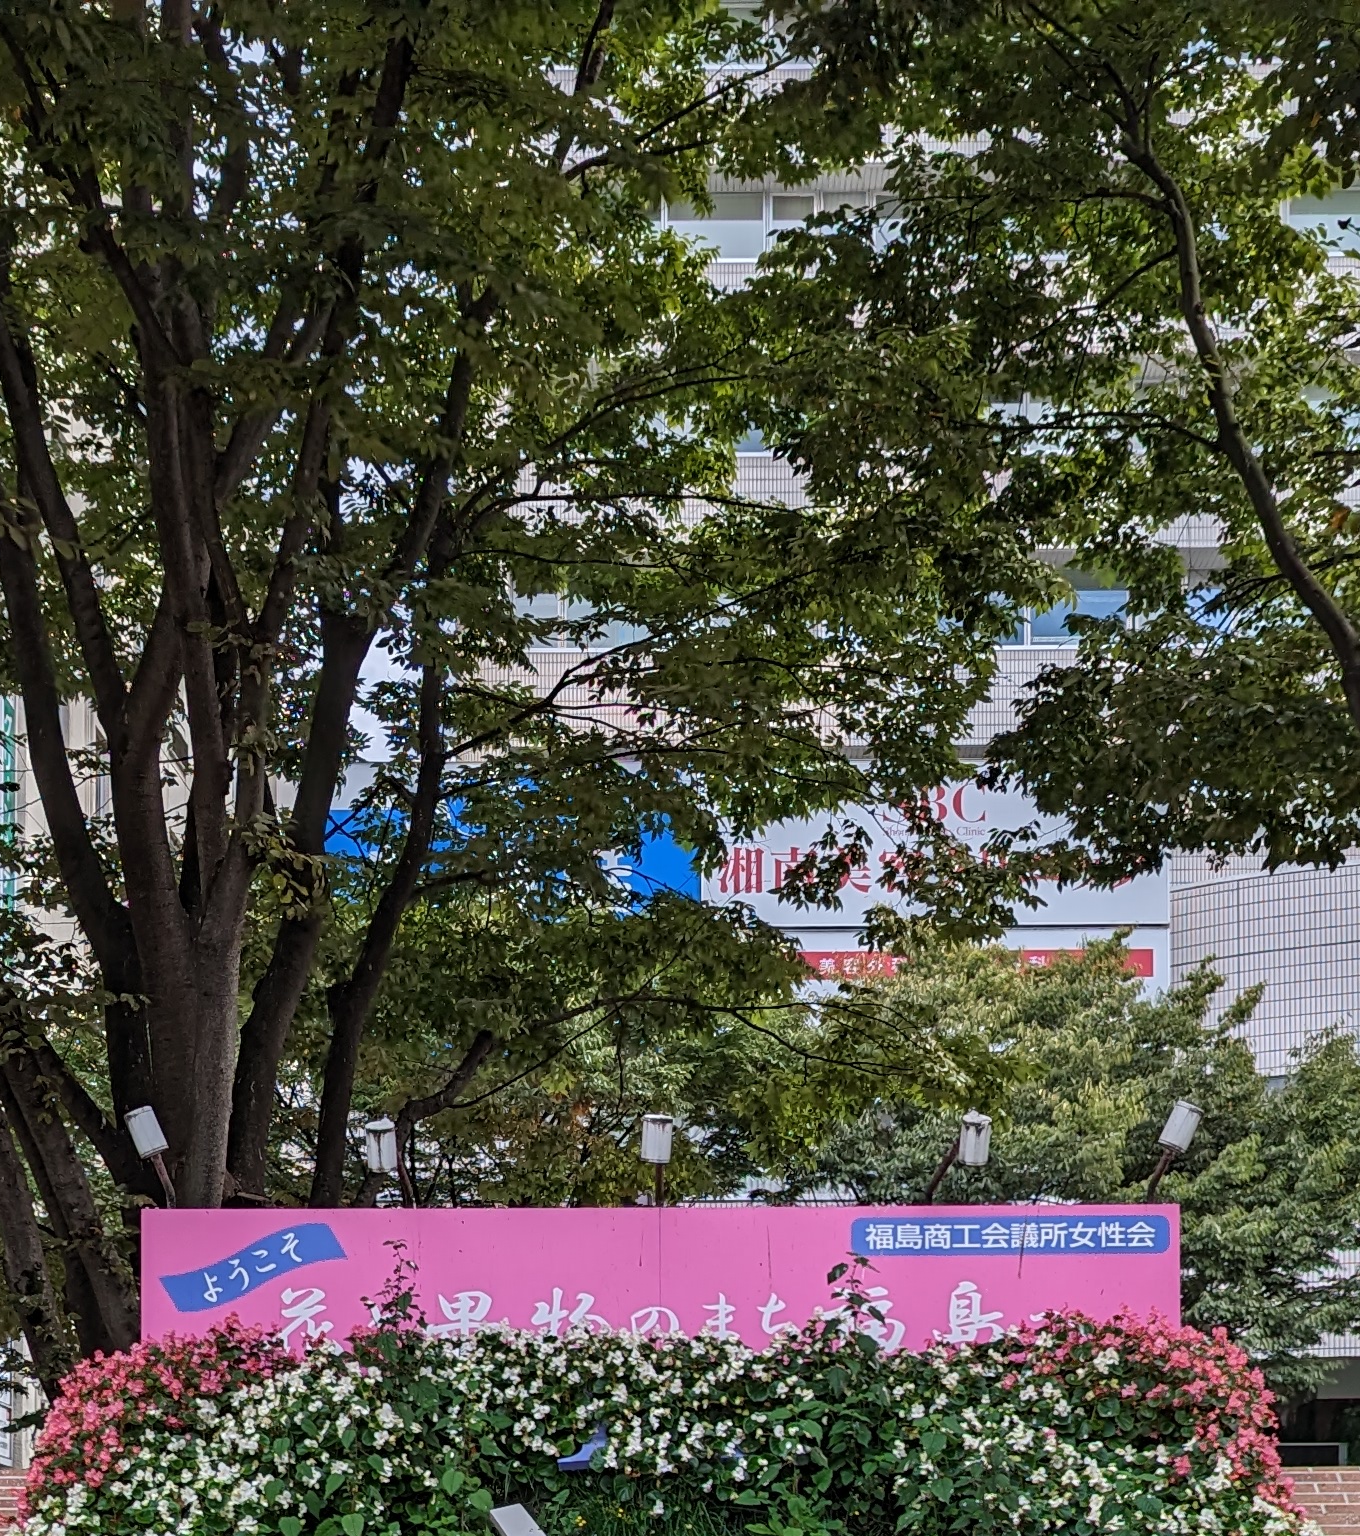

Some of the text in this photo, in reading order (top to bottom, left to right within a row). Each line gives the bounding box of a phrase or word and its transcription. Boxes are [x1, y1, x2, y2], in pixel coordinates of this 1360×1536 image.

[883, 782, 986, 822] BC
[956, 826, 986, 836] Clinic
[865, 1221, 1157, 1250] 福島商工会議所女性会
[203, 1232, 303, 1303] ようこそ
